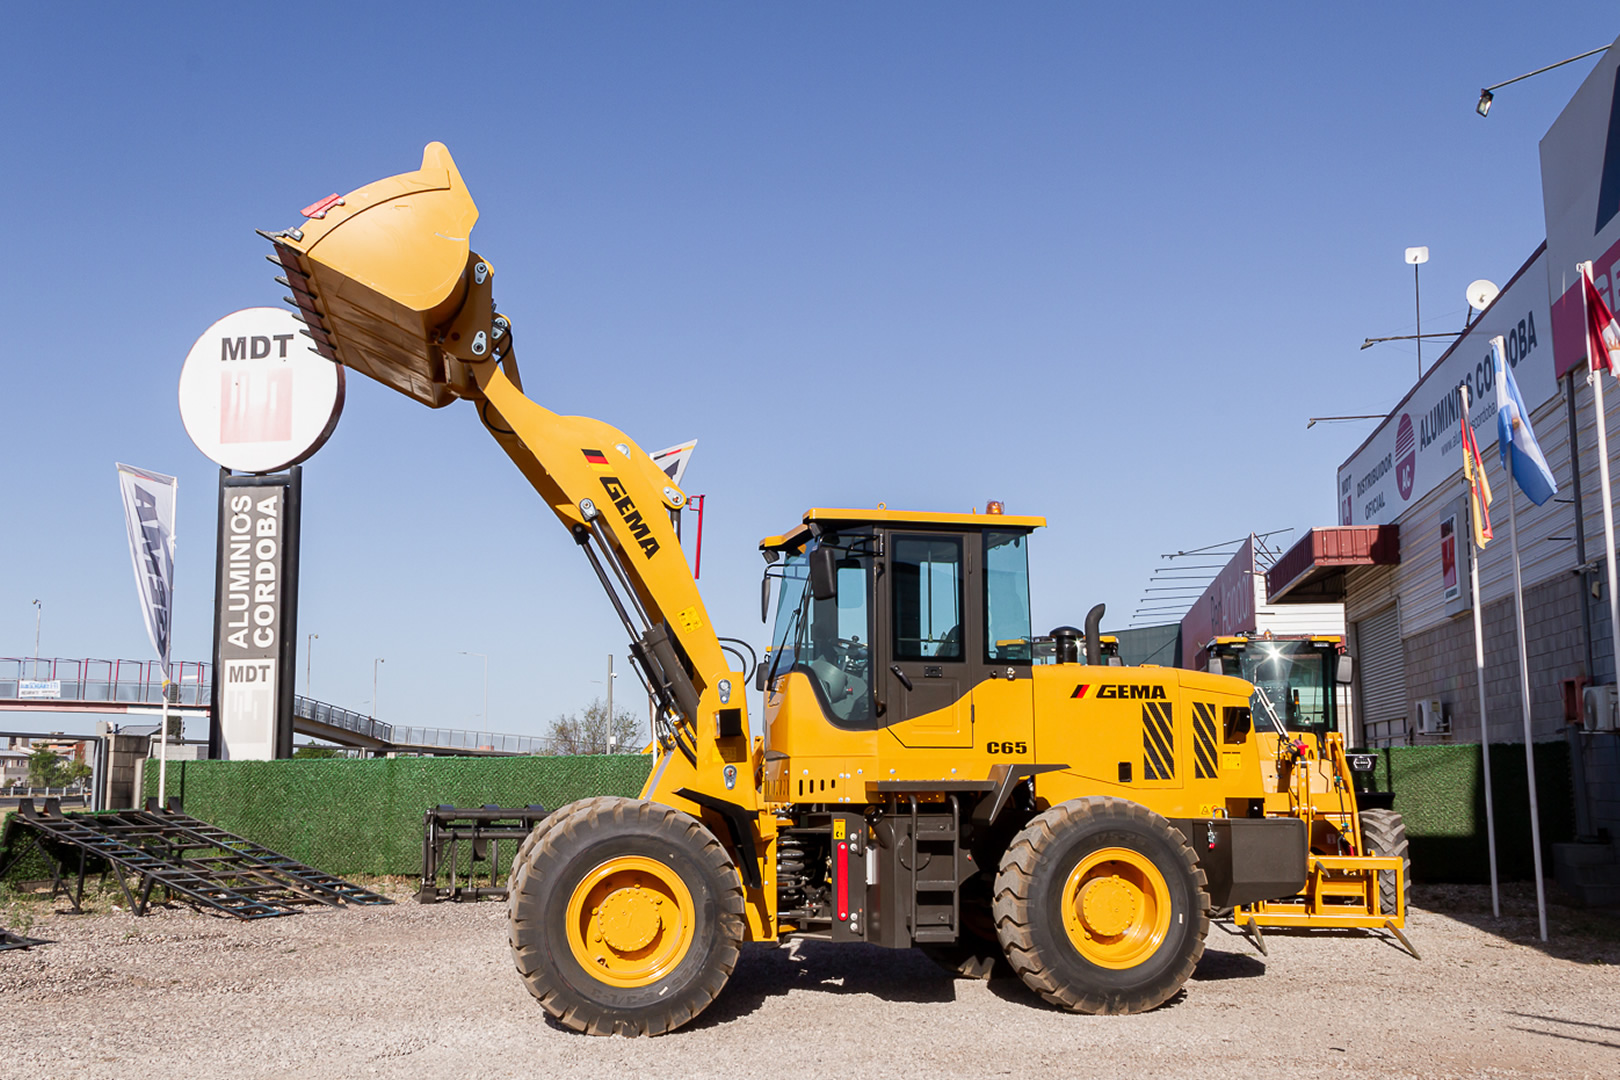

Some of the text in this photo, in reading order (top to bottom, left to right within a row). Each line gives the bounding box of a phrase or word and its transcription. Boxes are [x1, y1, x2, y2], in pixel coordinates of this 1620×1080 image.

[221, 334, 294, 361] MDT
[1357, 452, 1393, 498] DISTRIBUIDOR
[1402, 464, 1411, 492] AC
[599, 477, 660, 560] GEMA
[1365, 491, 1385, 520] OFICIAL
[228, 495, 252, 649] ALUMINIOS
[253, 495, 278, 648] CORDOBA
[229, 665, 270, 683] MDT
[1096, 685, 1166, 699] GEMA
[986, 741, 1027, 755] C65
